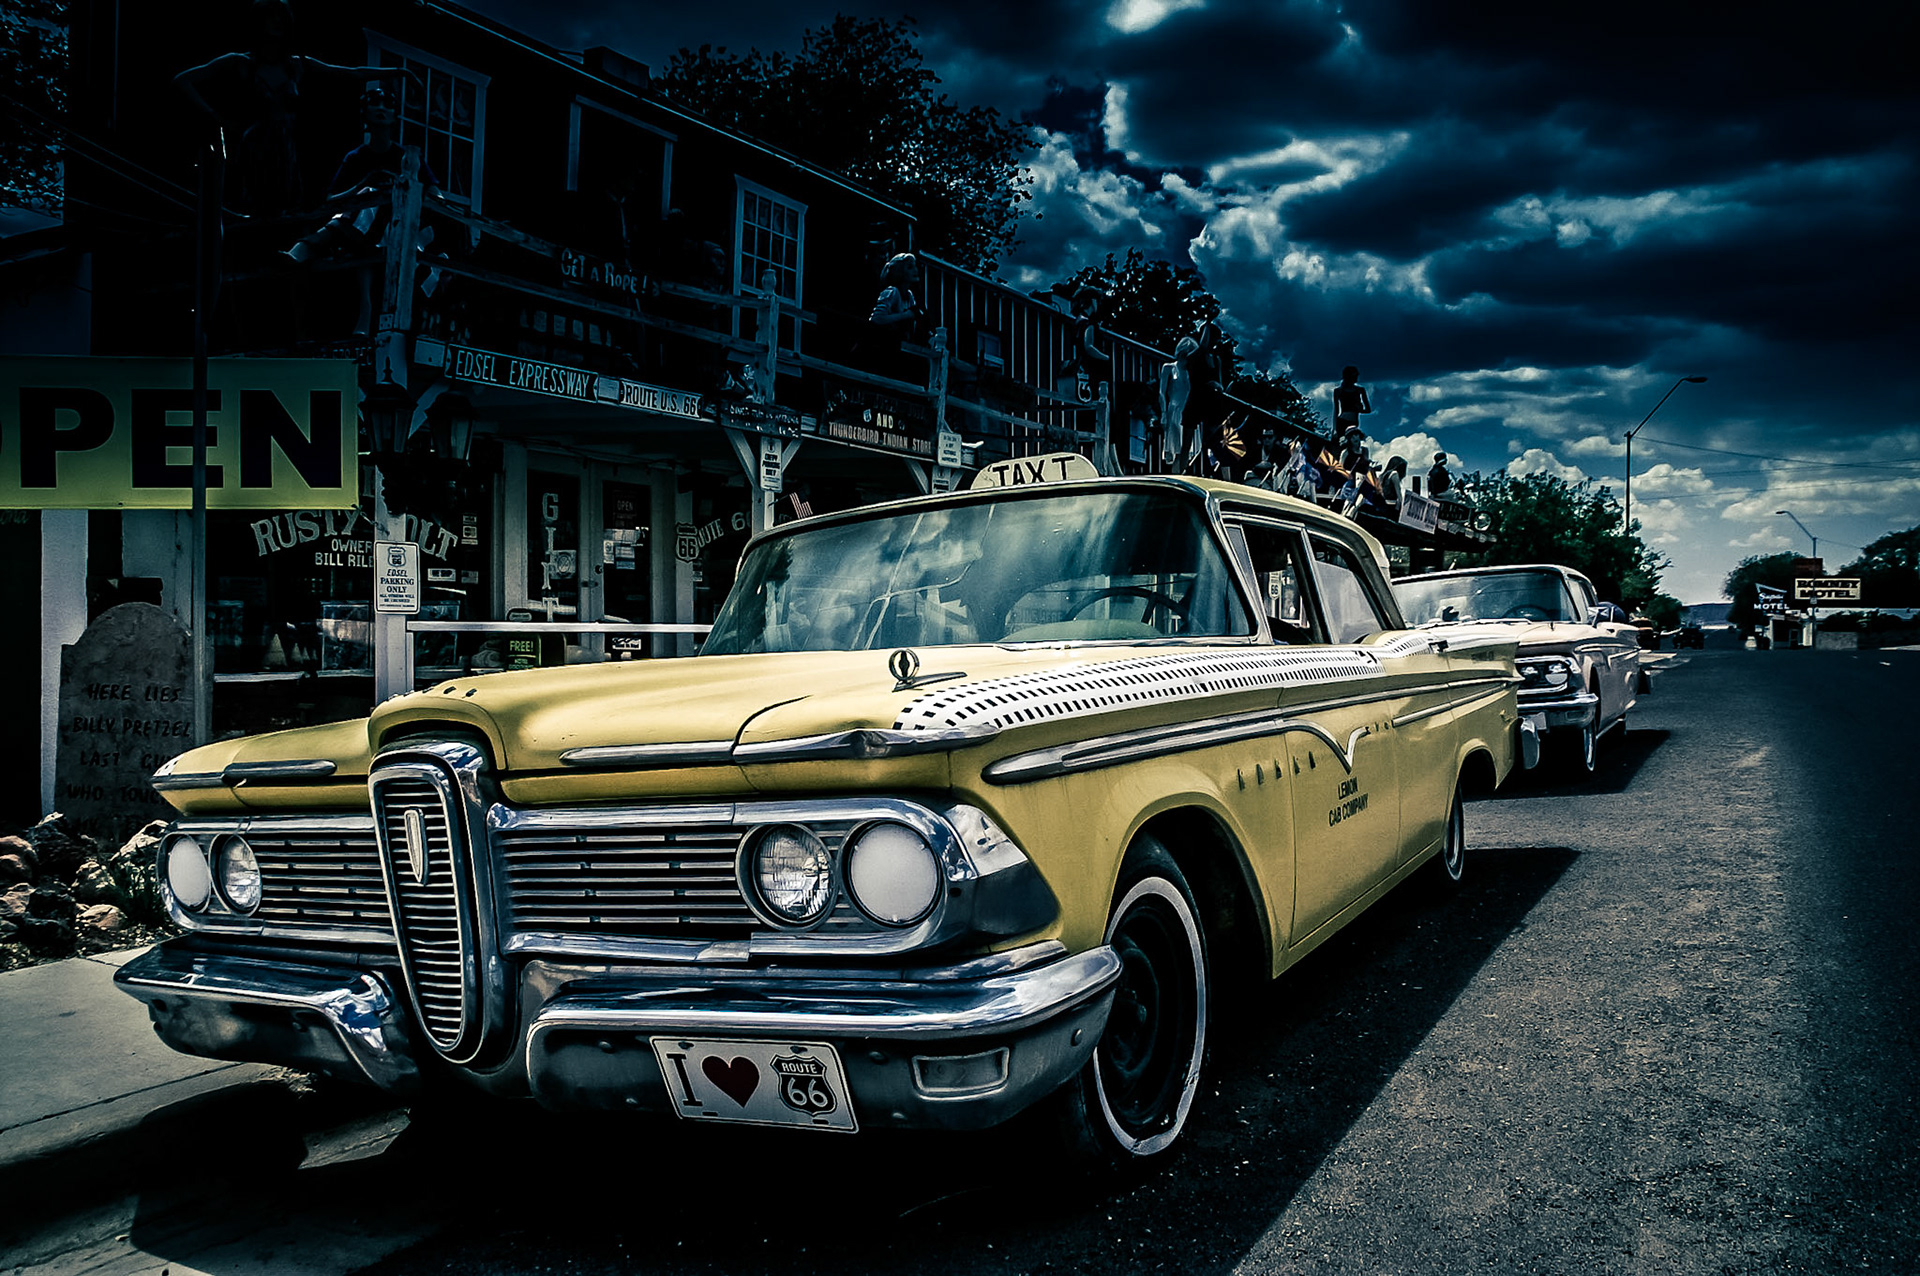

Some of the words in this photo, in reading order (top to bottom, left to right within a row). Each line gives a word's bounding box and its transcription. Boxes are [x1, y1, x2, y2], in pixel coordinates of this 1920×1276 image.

[456, 350, 497, 382] EDSEL
[509, 360, 590, 398] EXPRESSWAY
[625, 383, 658, 407] ROUTE
[661, 393, 680, 412] U.S.
[683, 396, 696, 415] 66
[877, 412, 894, 429] AND
[0, 386, 342, 488] PEN
[829, 422, 879, 444] THUNDERBIRD
[883, 432, 908, 449] INDIAN
[251, 509, 361, 557] RUSTY
[406, 512, 458, 561] LT
[698, 518, 724, 548] OUTE
[331, 538, 373, 554] OWNER
[679, 538, 696, 558] 66
[314, 552, 344, 566] BILL
[348, 553, 374, 568] RILE
[380, 577, 414, 586] PARKING
[387, 568, 408, 577] EDSEL
[1801, 589, 1856, 598] MOTEL
[509, 640, 533, 652] FREE!
[88, 684, 131, 701] HERE
[145, 686, 181, 702] LIES
[73, 717, 116, 734] BILLY
[123, 720, 190, 737] PRETZEL
[80, 750, 120, 767] LAST
[141, 753, 172, 770] GU
[67, 784, 103, 801] WHO
[120, 786, 167, 806] TOUC
[1338, 777, 1358, 800] LEMON
[1329, 806, 1341, 827] CAB
[1342, 793, 1368, 820] COMPANY
[781, 1062, 818, 1075] ROUTE
[666, 1054, 703, 1107] I
[786, 1077, 829, 1108] 66
